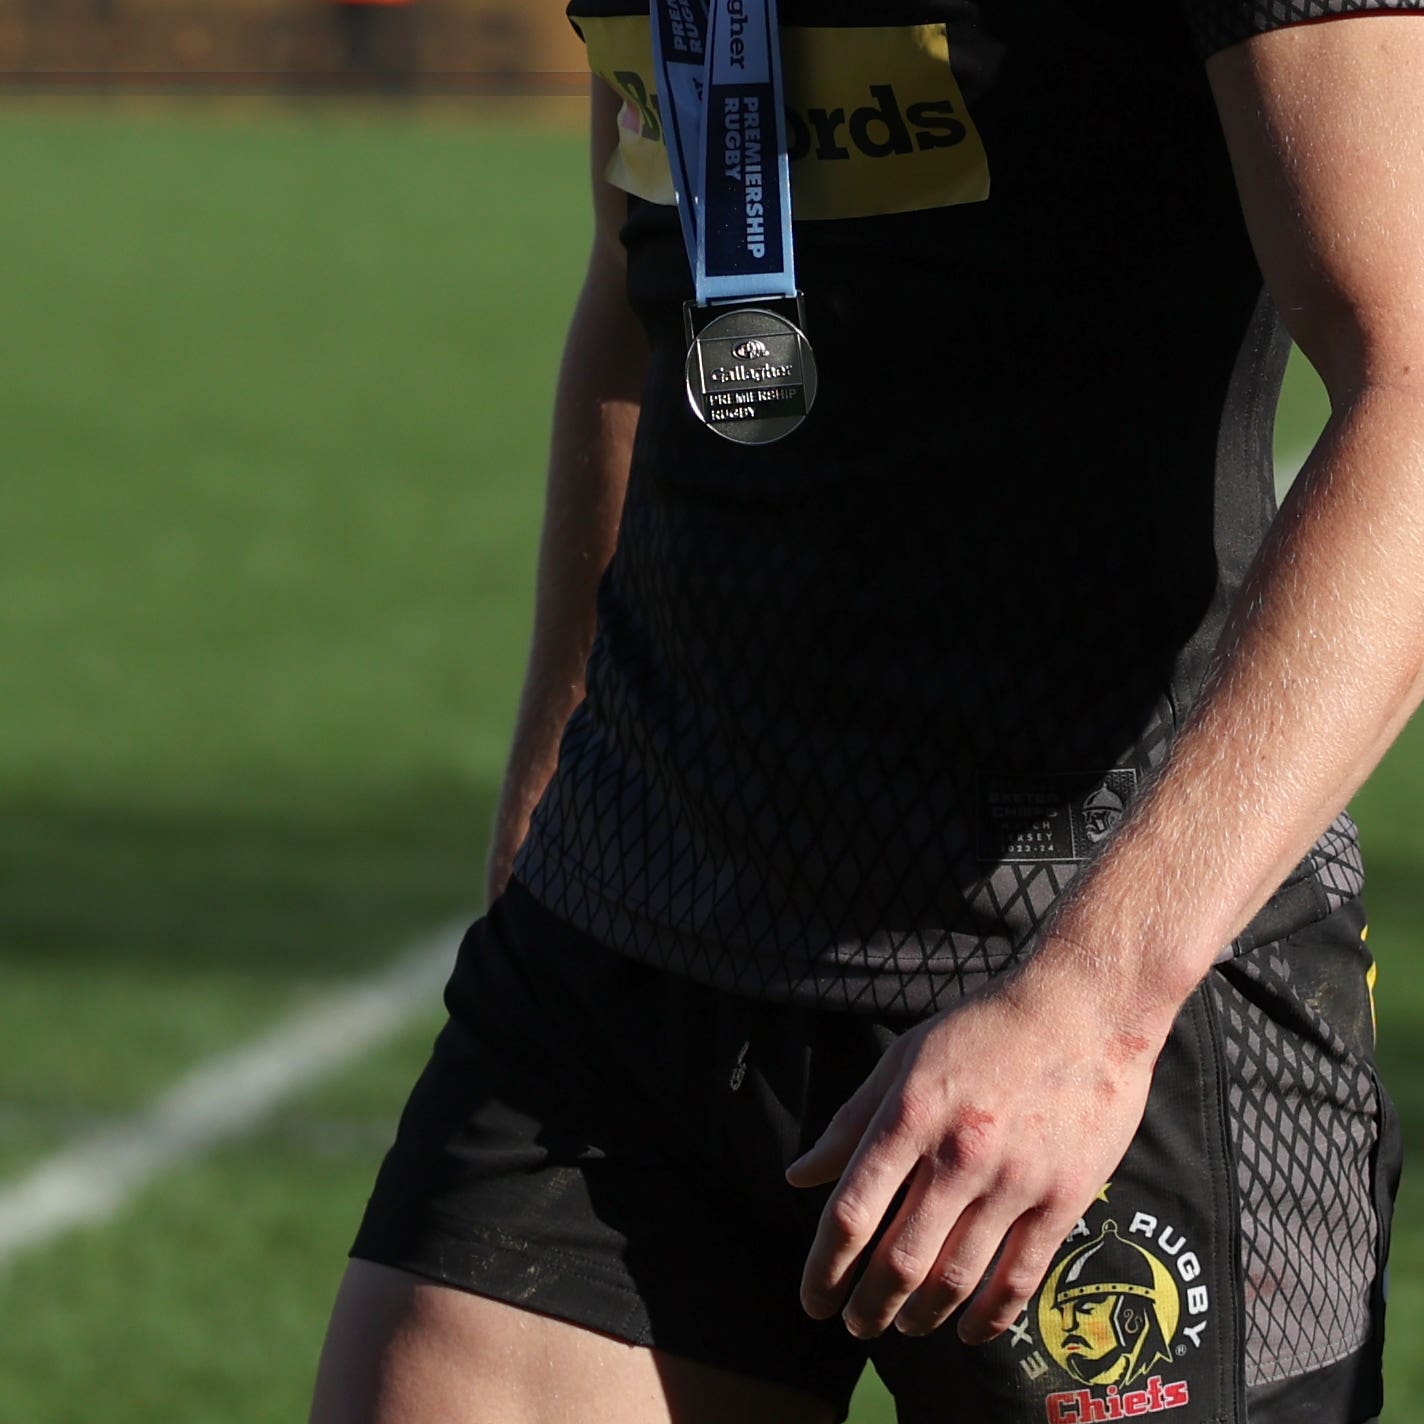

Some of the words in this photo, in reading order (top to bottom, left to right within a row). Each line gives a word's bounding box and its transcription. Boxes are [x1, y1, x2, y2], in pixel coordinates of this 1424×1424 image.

[723, 96, 742, 182] RUGBY
[742, 96, 766, 259] PREMIERSHIP
[709, 388, 797, 407] PREMIERSHIP
[711, 363, 792, 383] Gallagher
[1129, 1211, 1209, 1348] RUGBY
[1045, 1375, 1189, 1424] Chiefs
